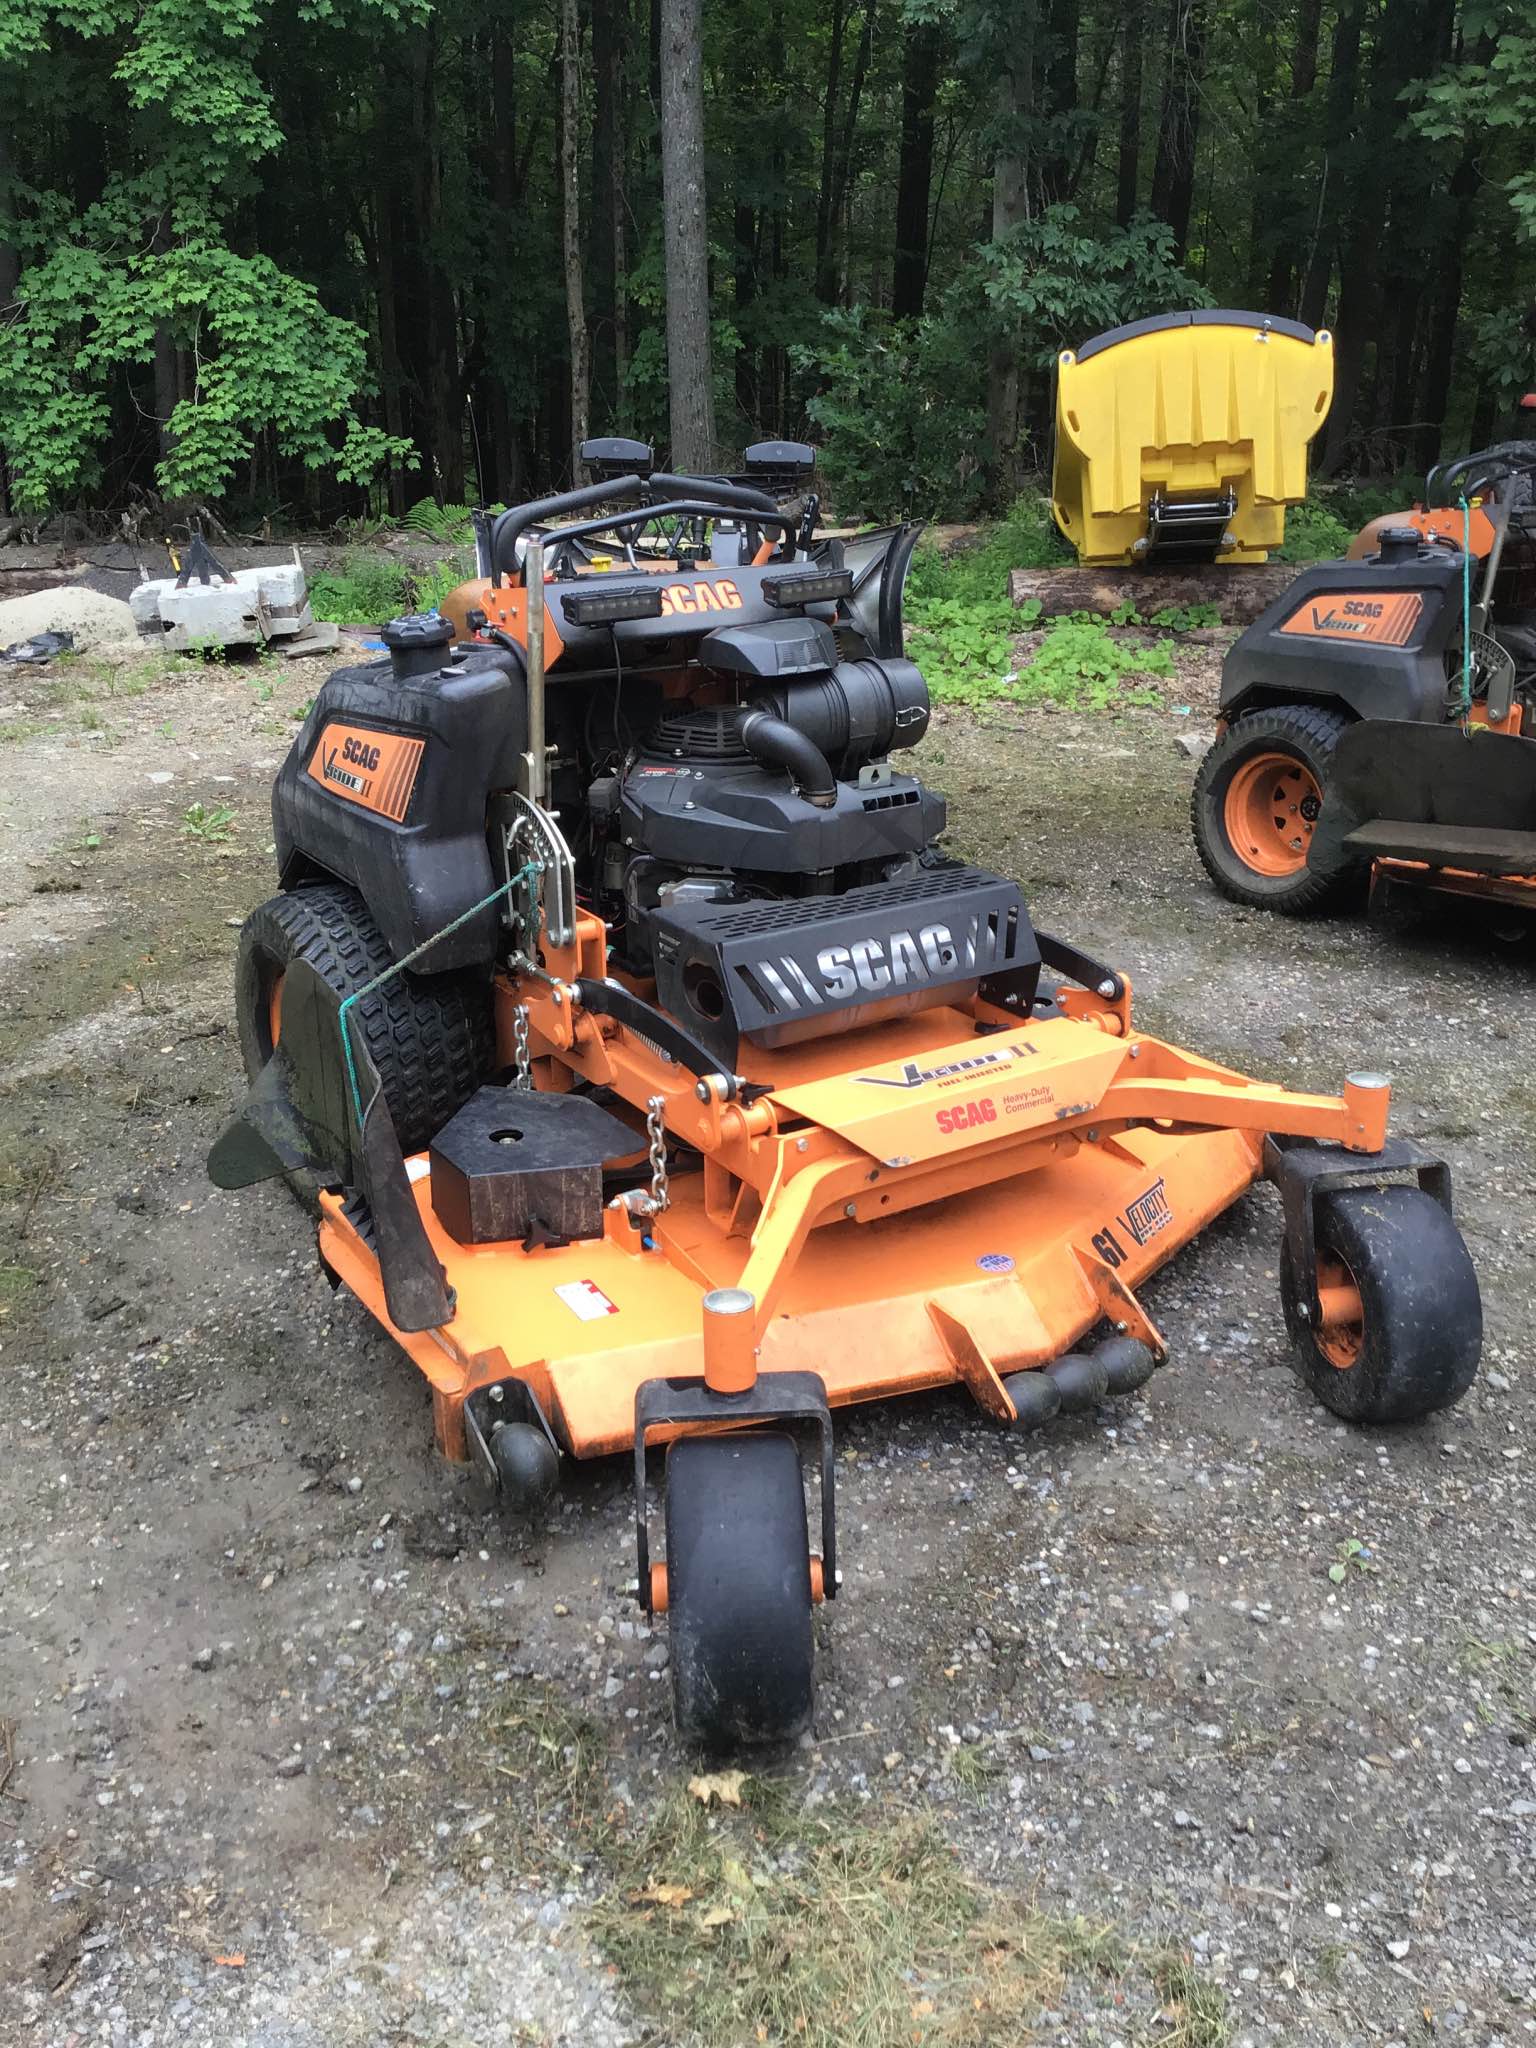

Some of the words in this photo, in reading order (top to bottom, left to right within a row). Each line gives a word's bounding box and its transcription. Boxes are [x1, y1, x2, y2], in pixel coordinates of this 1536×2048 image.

[1343, 601, 1383, 618] SCAG
[342, 736, 380, 771] SCAG
[816, 922, 959, 999] SCAG
[1003, 1086, 1050, 1105] Heavy-Duty
[1005, 1095, 1055, 1114] Commercial
[935, 1098, 997, 1134] SCAG
[1091, 1226, 1128, 1268] 61
[1116, 1176, 1168, 1247] VELOCITY
